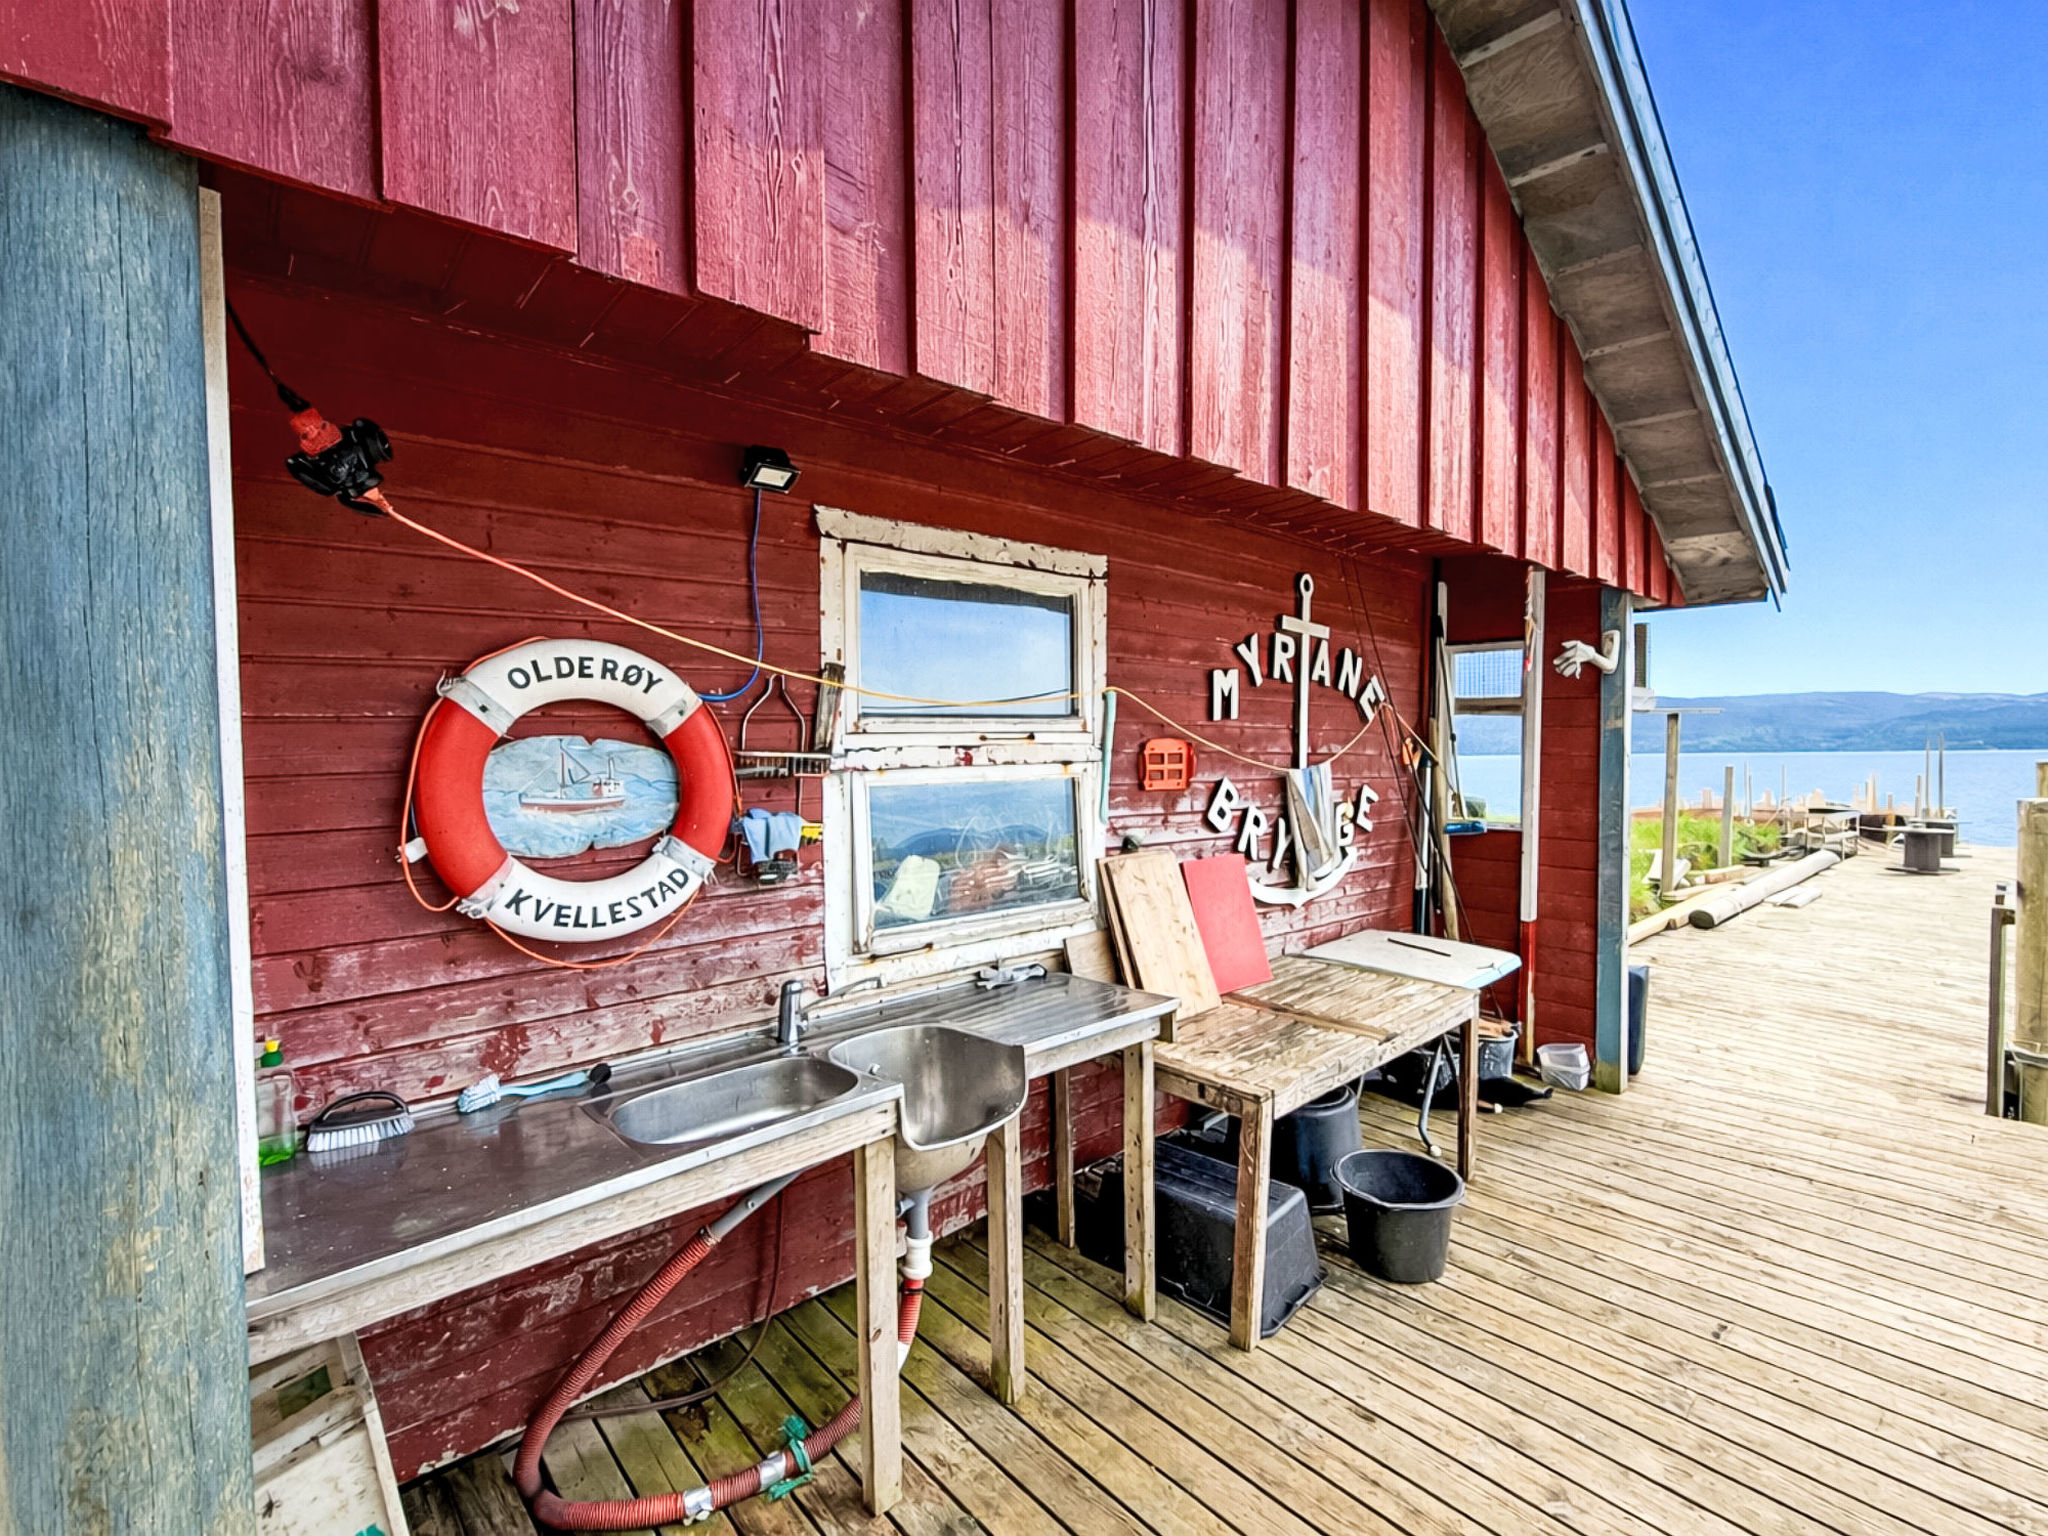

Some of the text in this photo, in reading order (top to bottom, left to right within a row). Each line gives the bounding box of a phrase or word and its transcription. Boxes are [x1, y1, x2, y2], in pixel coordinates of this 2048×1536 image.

[507, 656, 662, 694] OLDERØY
[1212, 633, 1386, 722] MYRANE
[1207, 776, 1379, 869] BRYGE
[504, 868, 689, 928] KVELLESTAD
